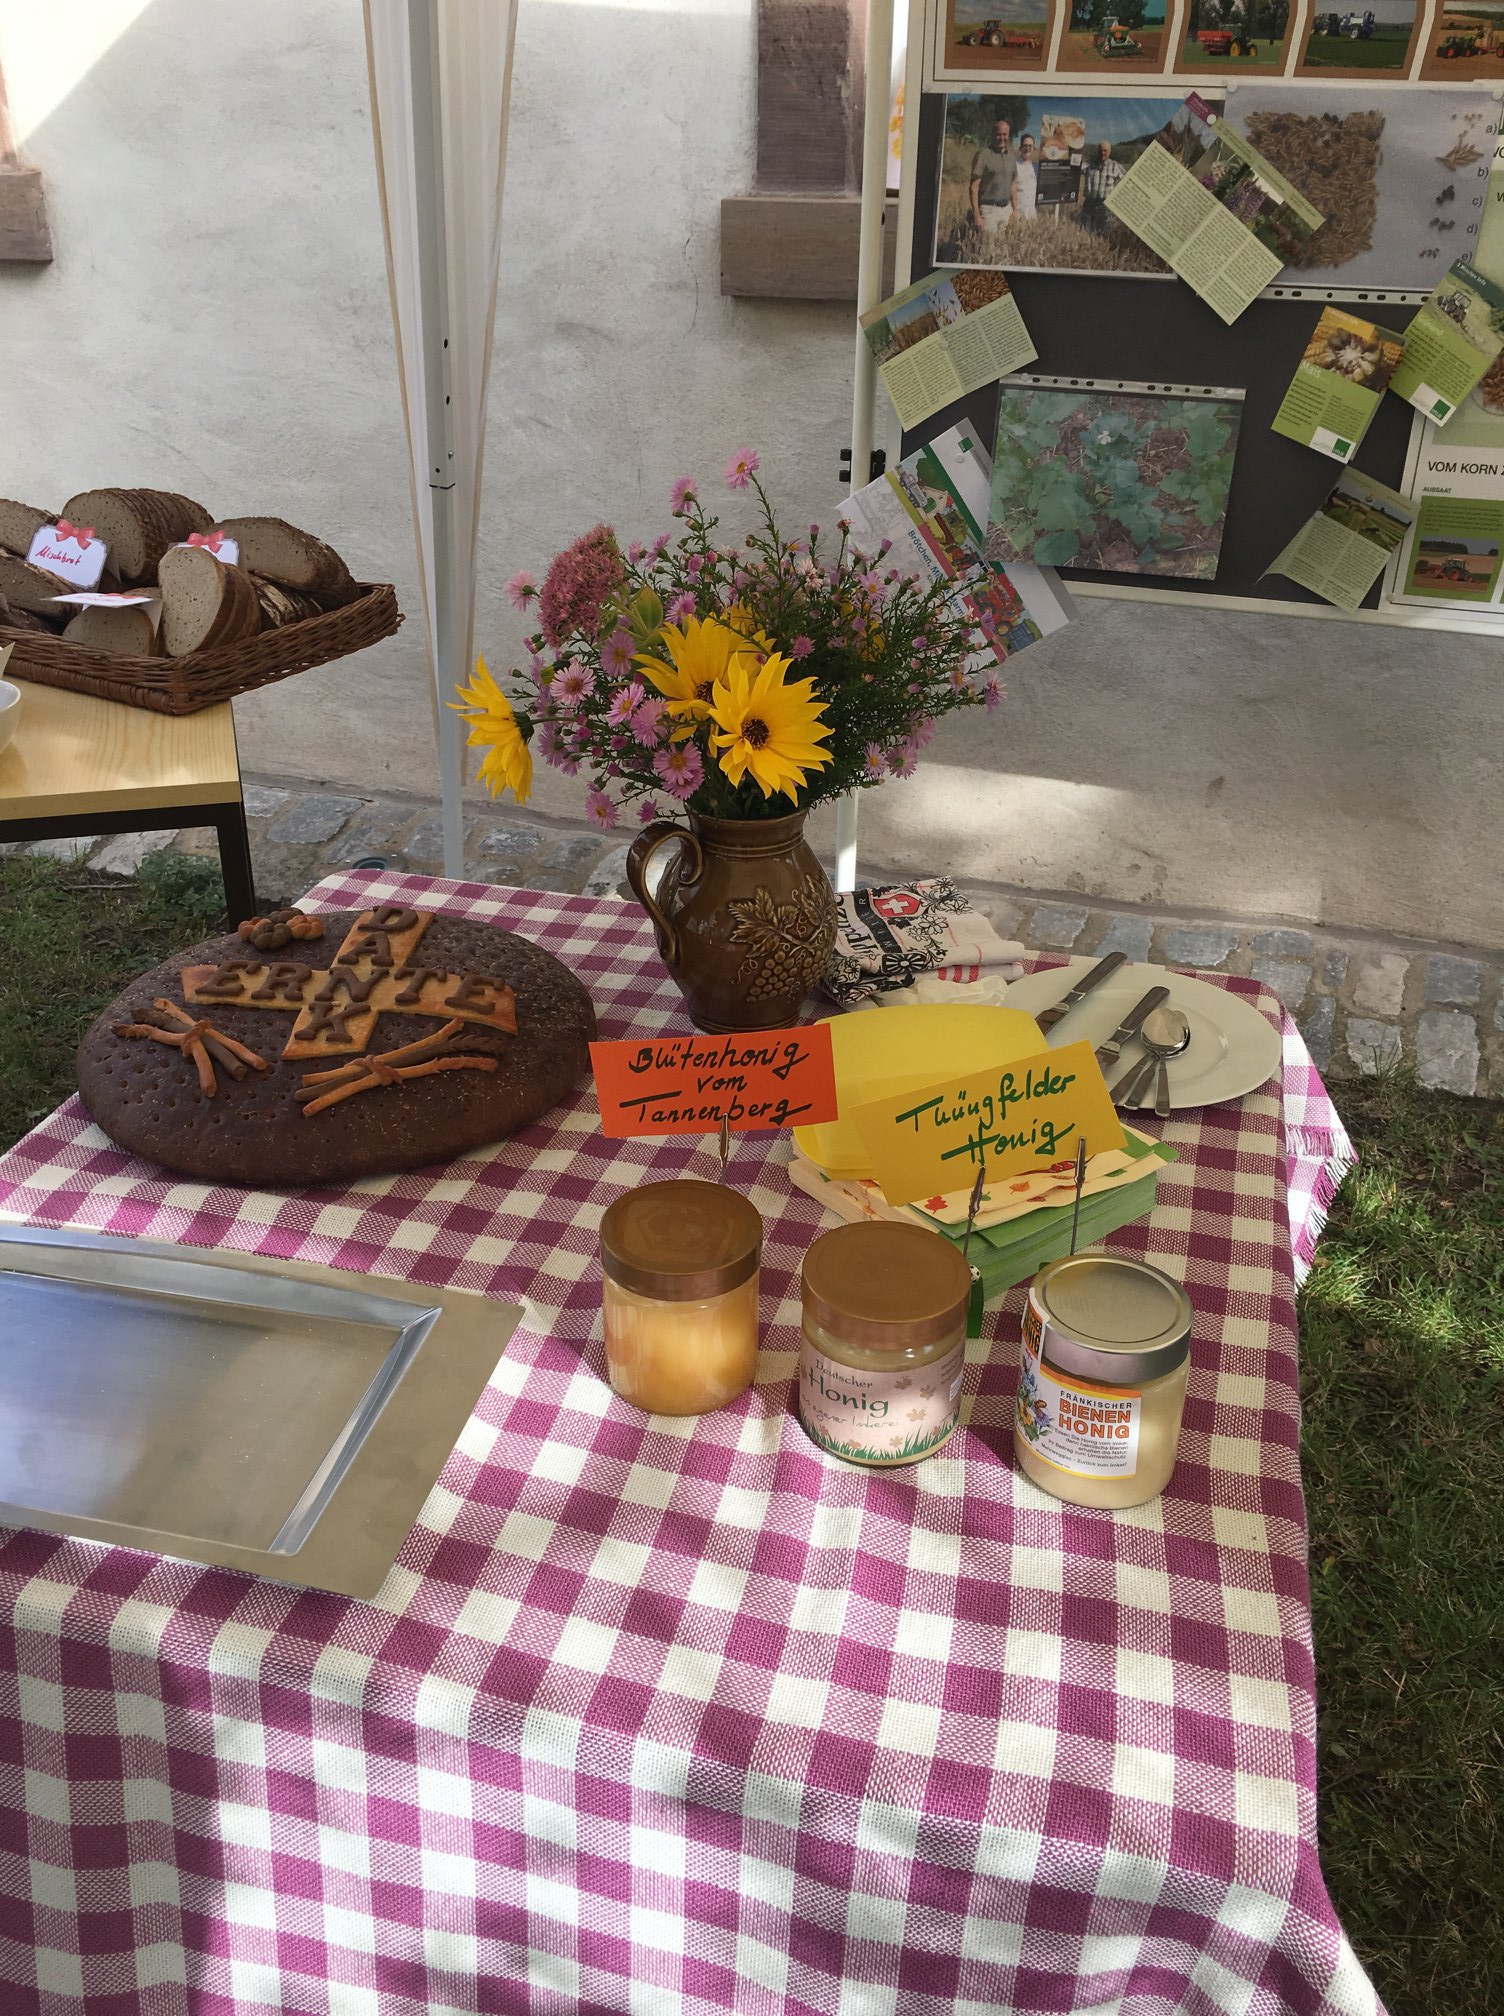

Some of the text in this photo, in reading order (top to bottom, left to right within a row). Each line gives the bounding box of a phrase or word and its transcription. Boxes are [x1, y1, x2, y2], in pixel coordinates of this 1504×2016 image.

[1477, 166, 1489, 181] b)
[1472, 195, 1483, 208] c)
[1466, 223, 1478, 236] d)
[1300, 361, 1322, 379] Mais
[1427, 460, 1457, 473] VOM
[1460, 463, 1498, 475] KORN
[1422, 486, 1452, 494] AUSSAAT
[35, 545, 81, 566] Mischbrot
[907, 530, 932, 567] Brötchen,
[194, 960, 506, 1015] ERNTE
[628, 1037, 810, 1080] Blütenhonig
[697, 1074, 748, 1094] vom
[619, 1090, 813, 1126] Tannenberg
[940, 1117, 1076, 1165] Honig
[815, 1358, 873, 1389] Deutscher
[808, 1366, 889, 1418] Honig
[1060, 1390, 1132, 1409] FRÄNKISCHER
[1059, 1398, 1131, 1423] BIENEN
[1058, 1413, 1130, 1439] HONIG
[1080, 1437, 1098, 1446] Honig
